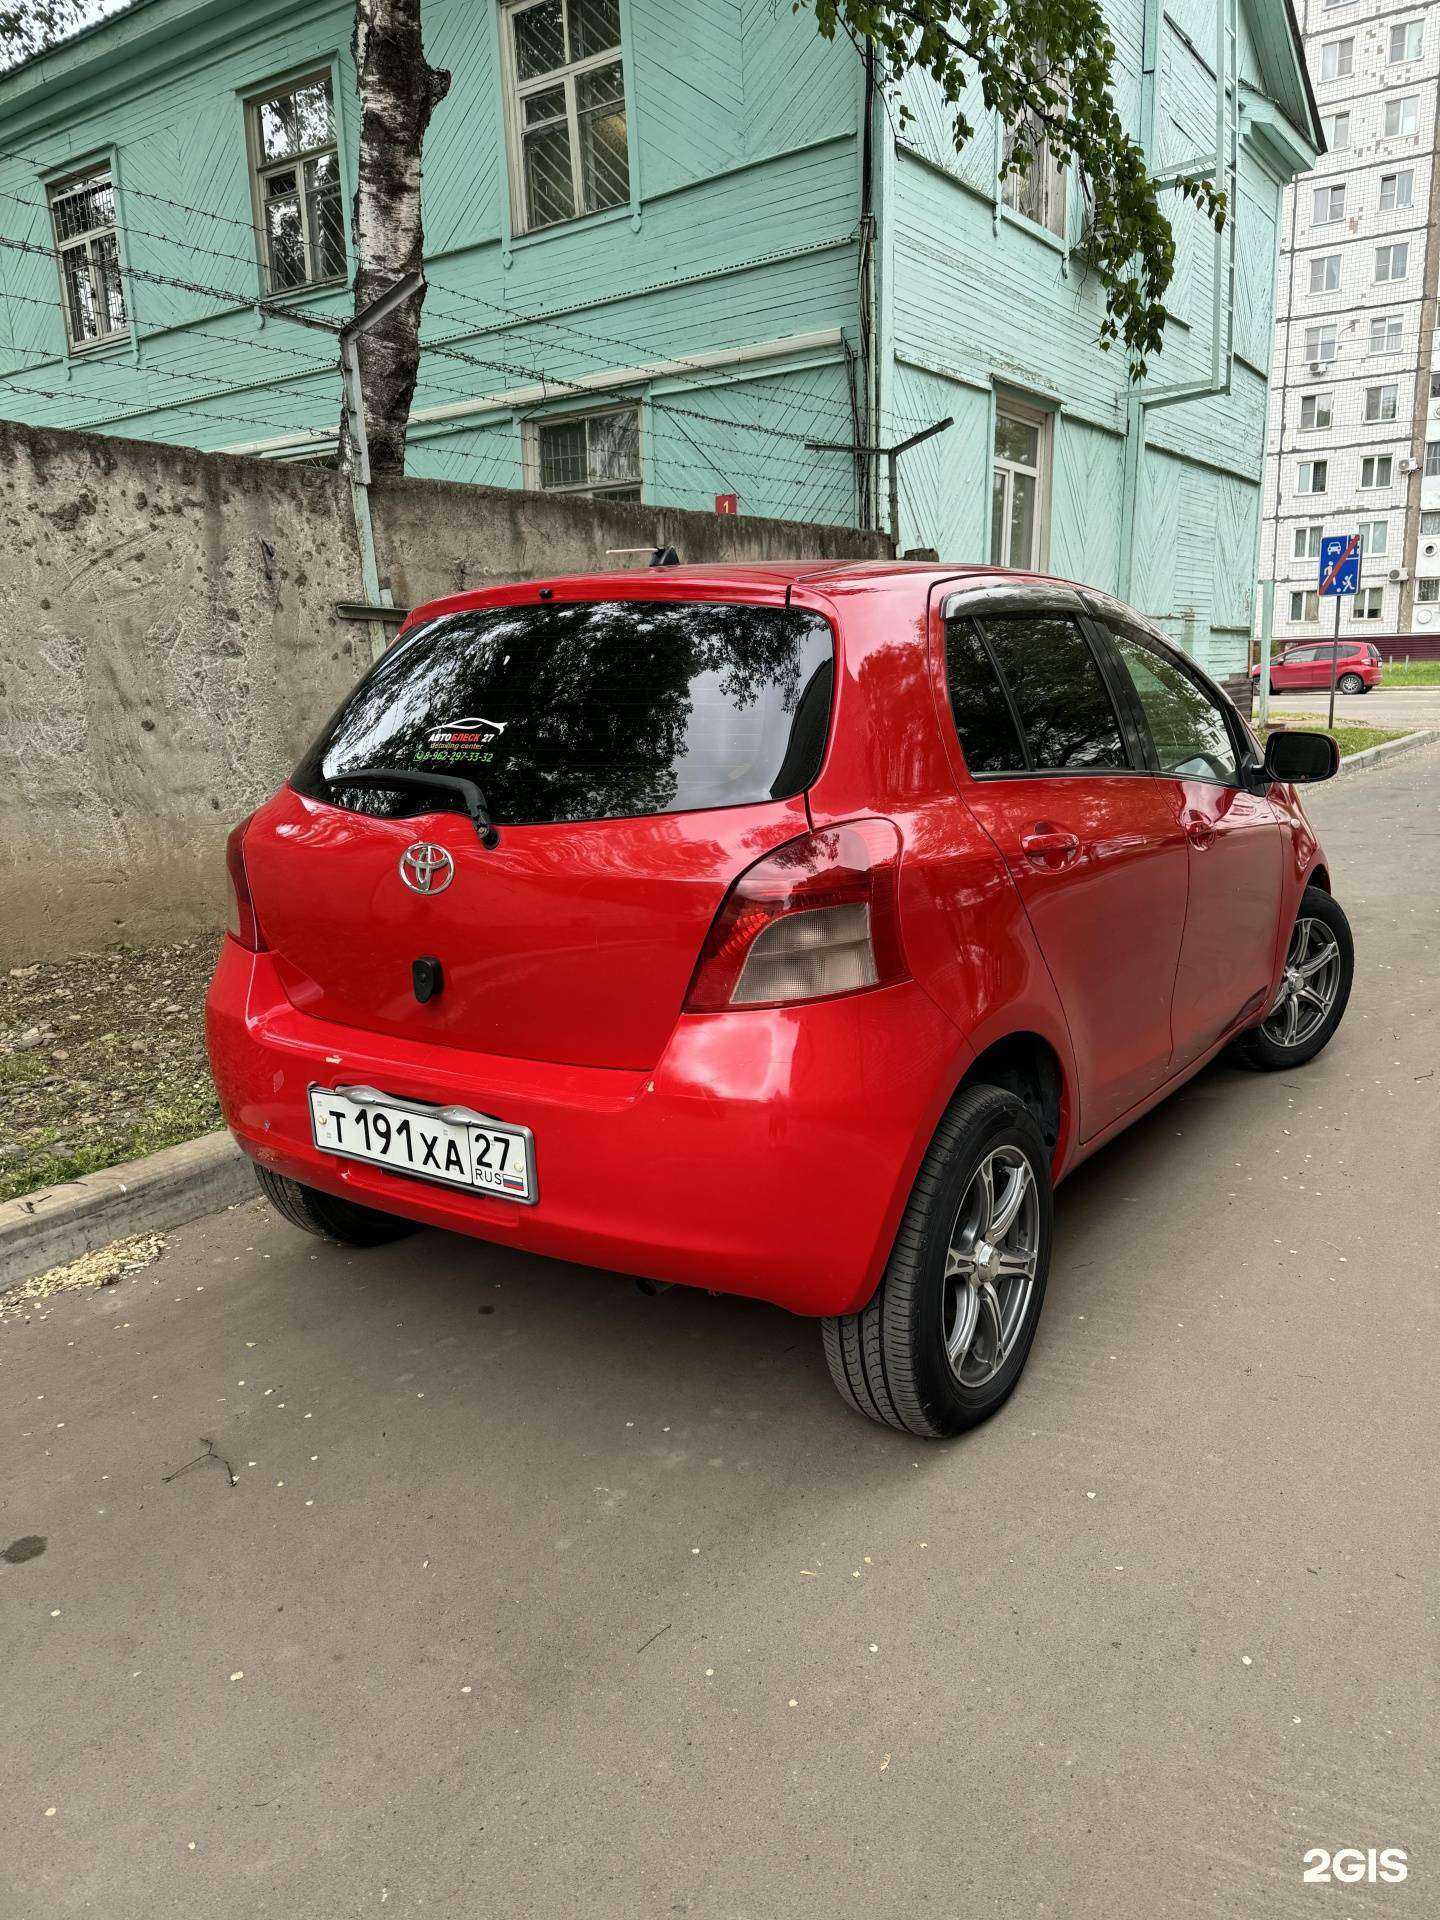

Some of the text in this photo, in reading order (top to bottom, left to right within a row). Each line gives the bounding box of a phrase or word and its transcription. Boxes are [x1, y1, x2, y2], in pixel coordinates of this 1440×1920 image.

[428, 733, 495, 743] АВТОБЛЕСК 27
[474, 1133, 510, 1171] 27
[475, 1168, 501, 1185] RUS
